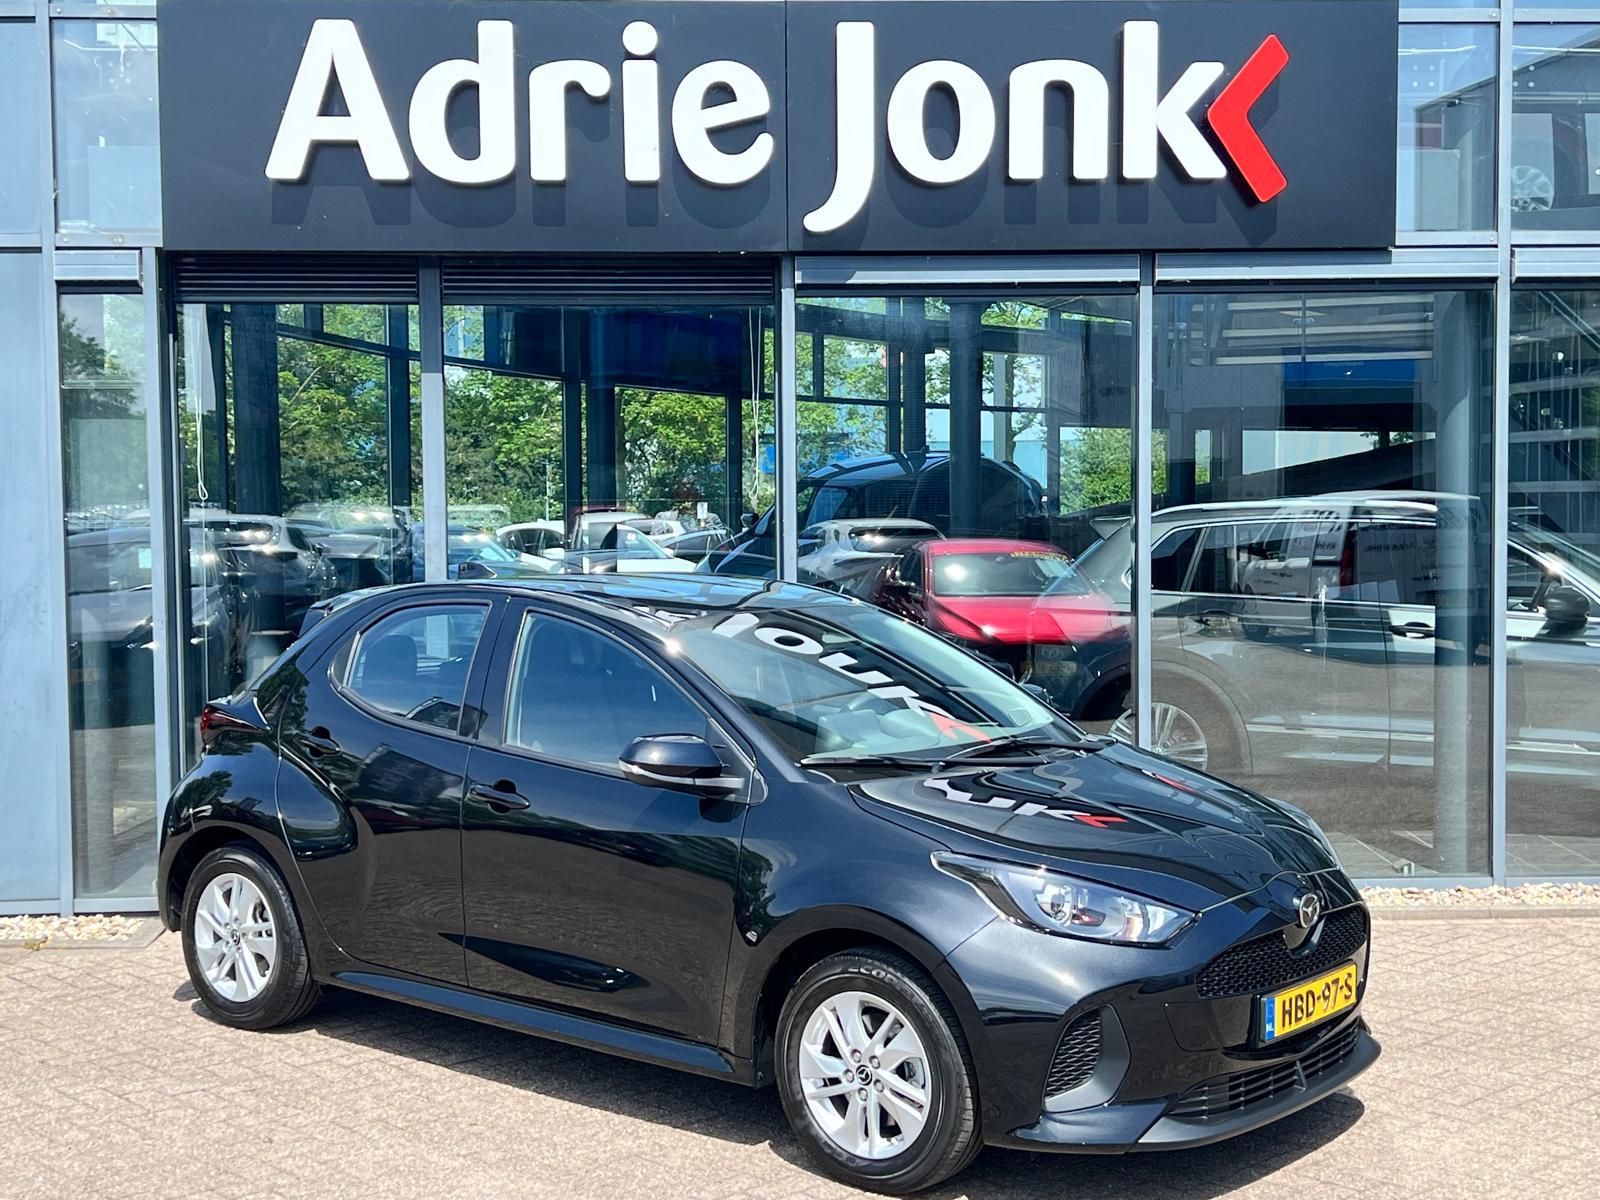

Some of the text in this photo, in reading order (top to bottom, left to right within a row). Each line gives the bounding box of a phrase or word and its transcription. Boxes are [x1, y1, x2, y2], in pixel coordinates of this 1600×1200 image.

[265, 18, 1228, 232] Adrie Jonk
[1281, 972, 1353, 1030] HBD-97-S
